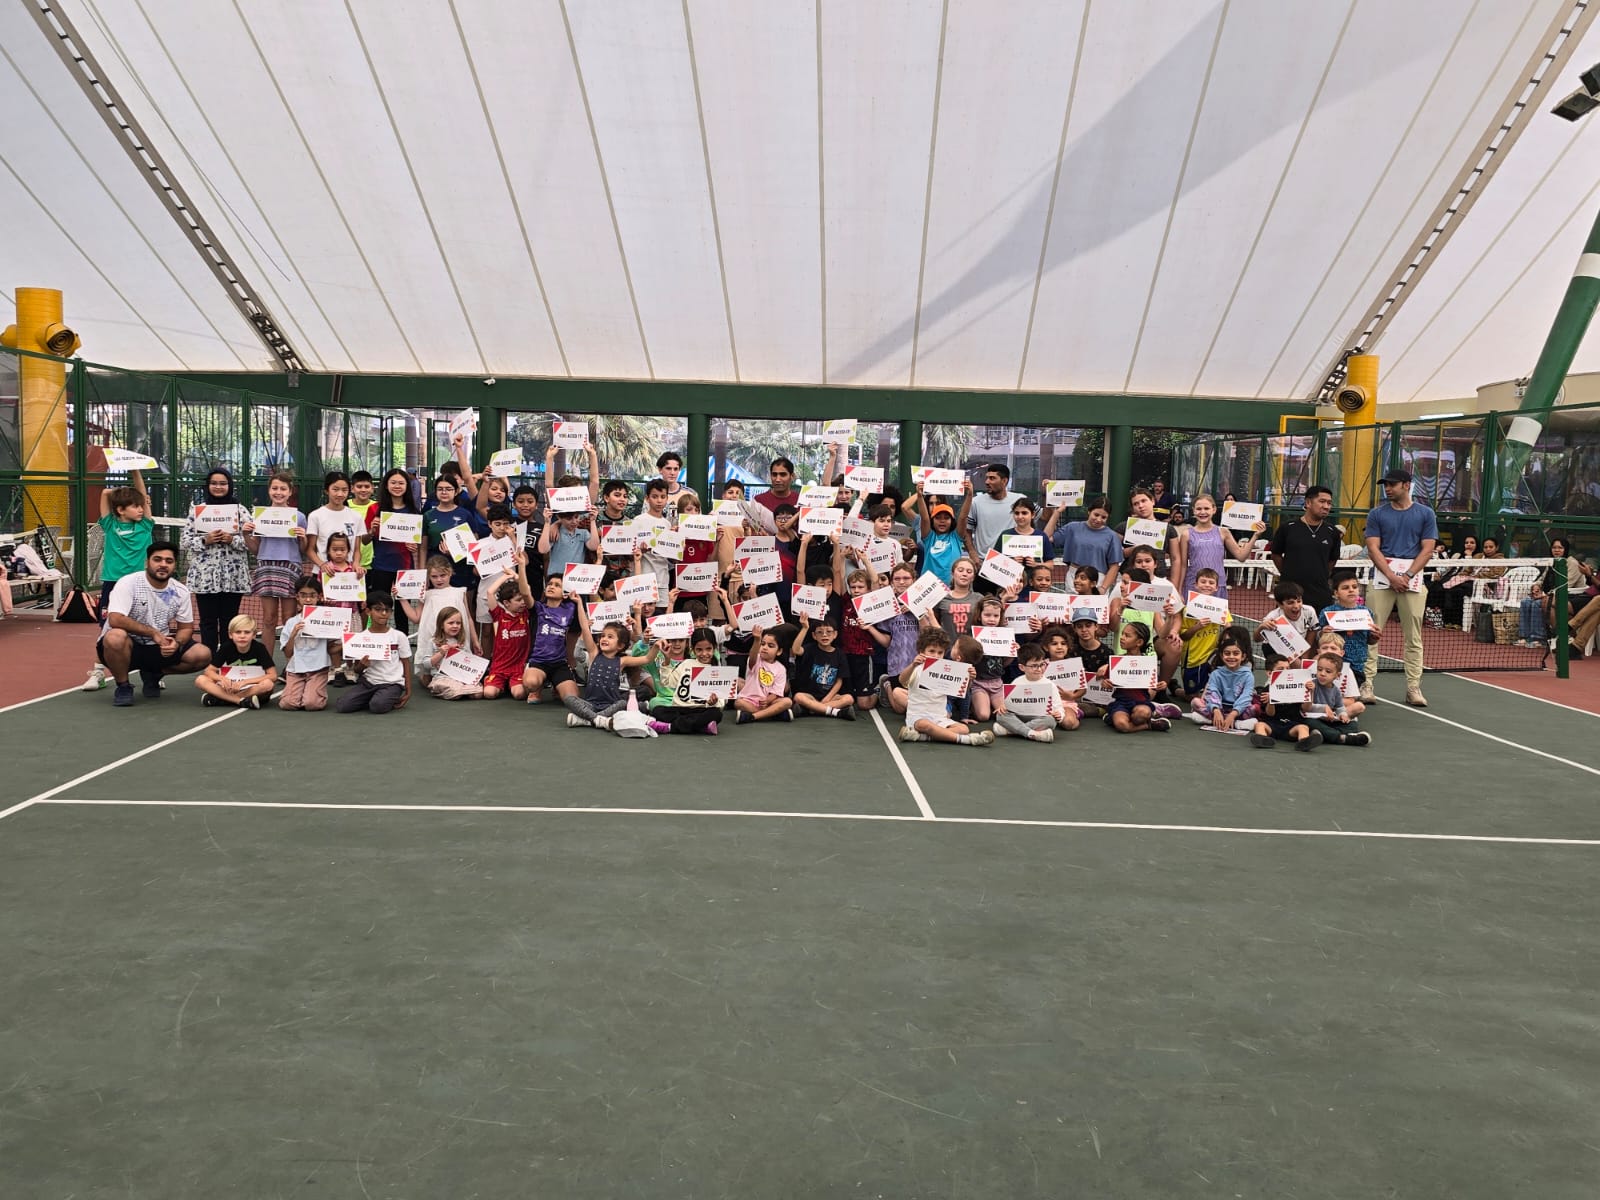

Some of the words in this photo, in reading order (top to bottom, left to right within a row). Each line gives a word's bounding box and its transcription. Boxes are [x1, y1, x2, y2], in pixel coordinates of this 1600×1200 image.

[688, 547, 694, 556] 9
[490, 553, 503, 562] ACED
[999, 568, 1010, 576] ACED
[913, 596, 923, 605] YOU
[921, 587, 933, 598] ACED
[873, 602, 885, 610] ACED
[949, 603, 971, 613] JUST
[954, 613, 968, 623] DO
[956, 623, 967, 633] IT.
[1280, 636, 1291, 647] ACED
[459, 664, 472, 672] ACED
